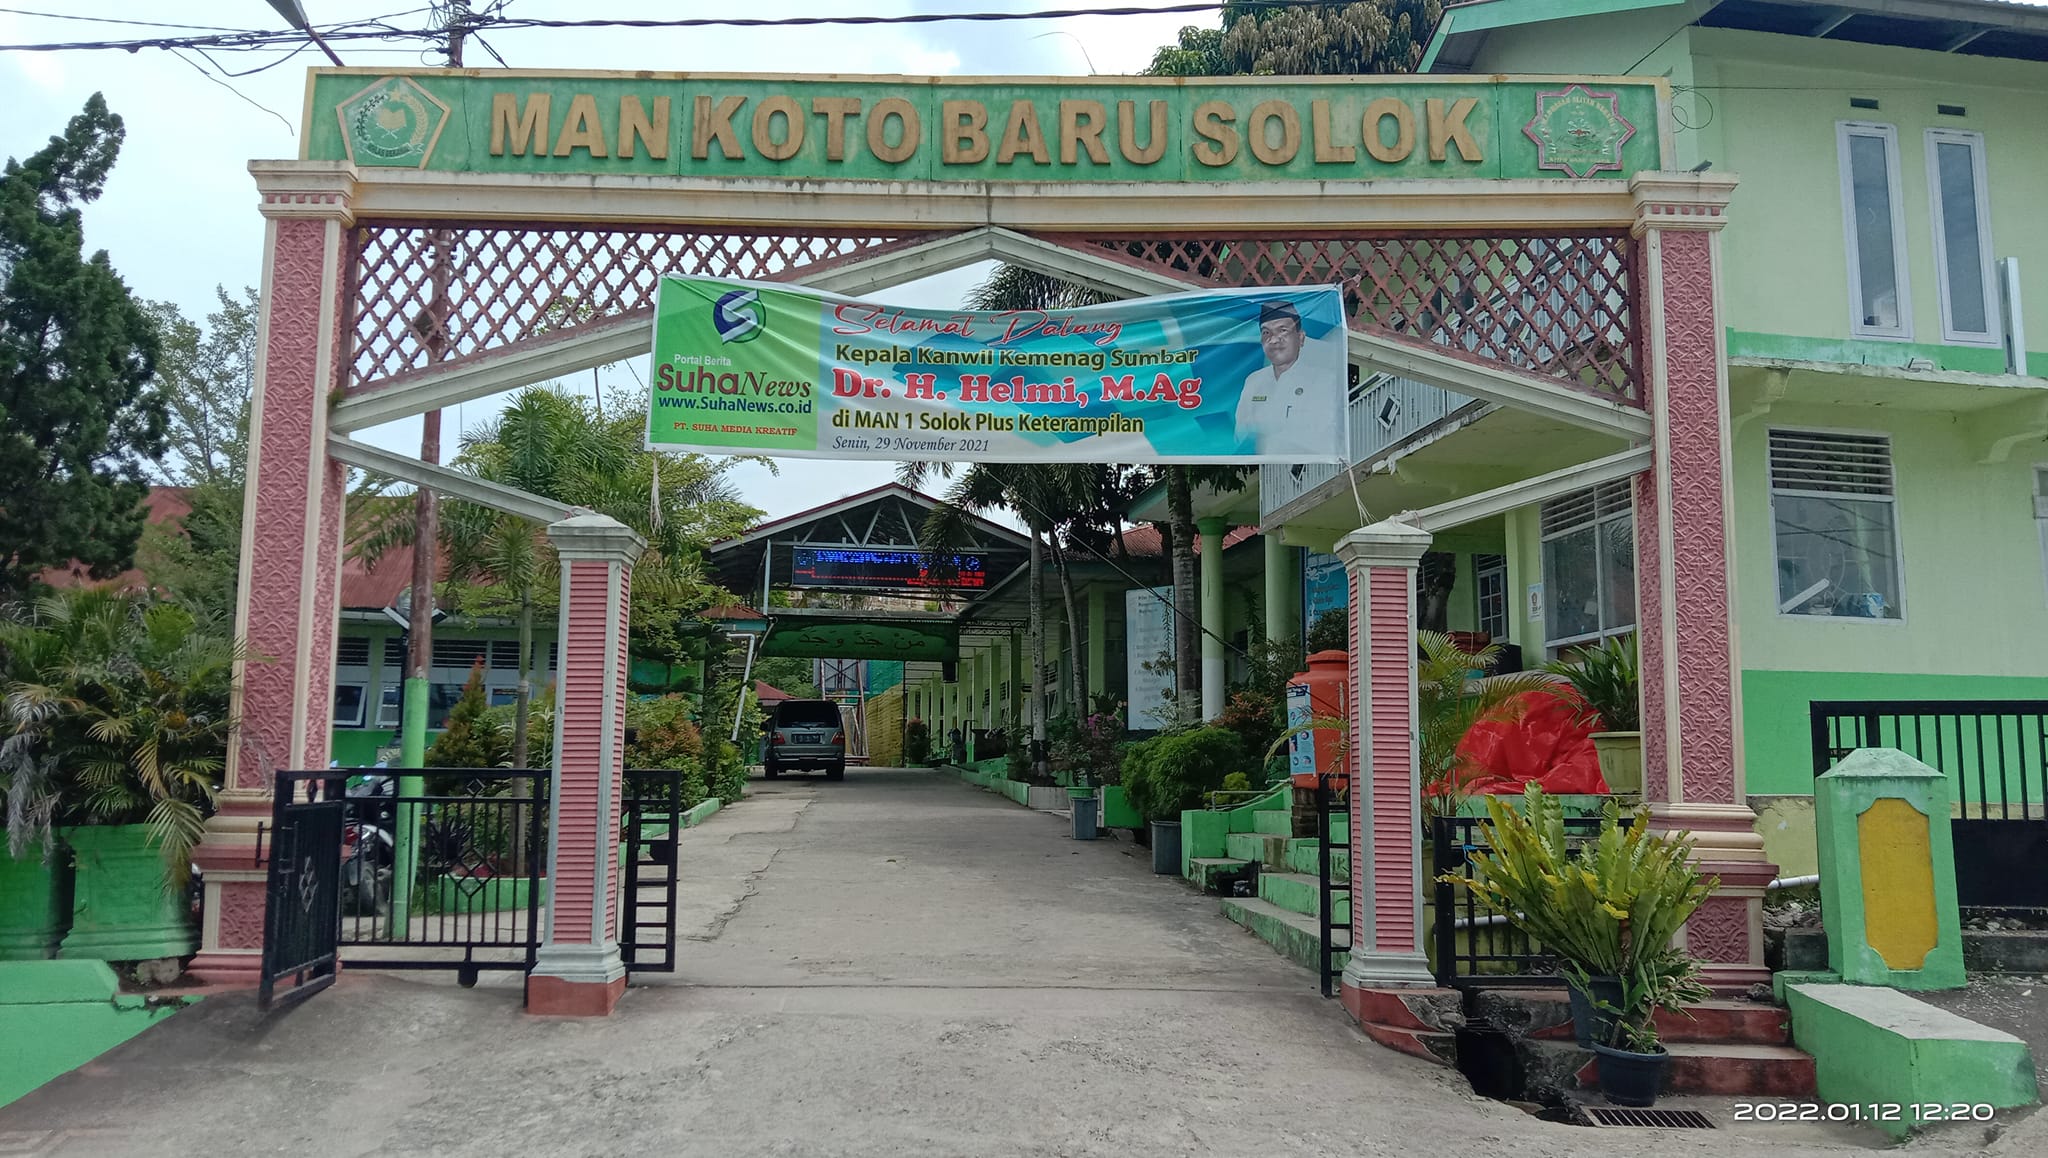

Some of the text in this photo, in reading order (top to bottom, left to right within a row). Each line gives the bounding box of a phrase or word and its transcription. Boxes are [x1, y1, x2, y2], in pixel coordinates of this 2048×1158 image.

[489, 92, 670, 160] MAN
[692, 96, 921, 163] KOTO
[942, 99, 1168, 166] BARU
[1190, 98, 1484, 167] SOLOK
[832, 303, 1122, 347] Selamat Datang
[674, 353, 732, 367] Portal Berita
[835, 344, 1199, 370] Kepala Kanwil Kemenag Sumbar
[656, 363, 812, 398] SuhaNews
[832, 367, 1202, 410] Dr. H. Helmi, M.Ag
[658, 396, 813, 414] www.SuhaNews.co.id
[673, 422, 799, 436] PT. SUHA MEDIA KREATIF
[832, 409, 1144, 437] di MAN 1 Solok Plus Keterampilan
[832, 436, 990, 452] Senin, 29 November 2021
